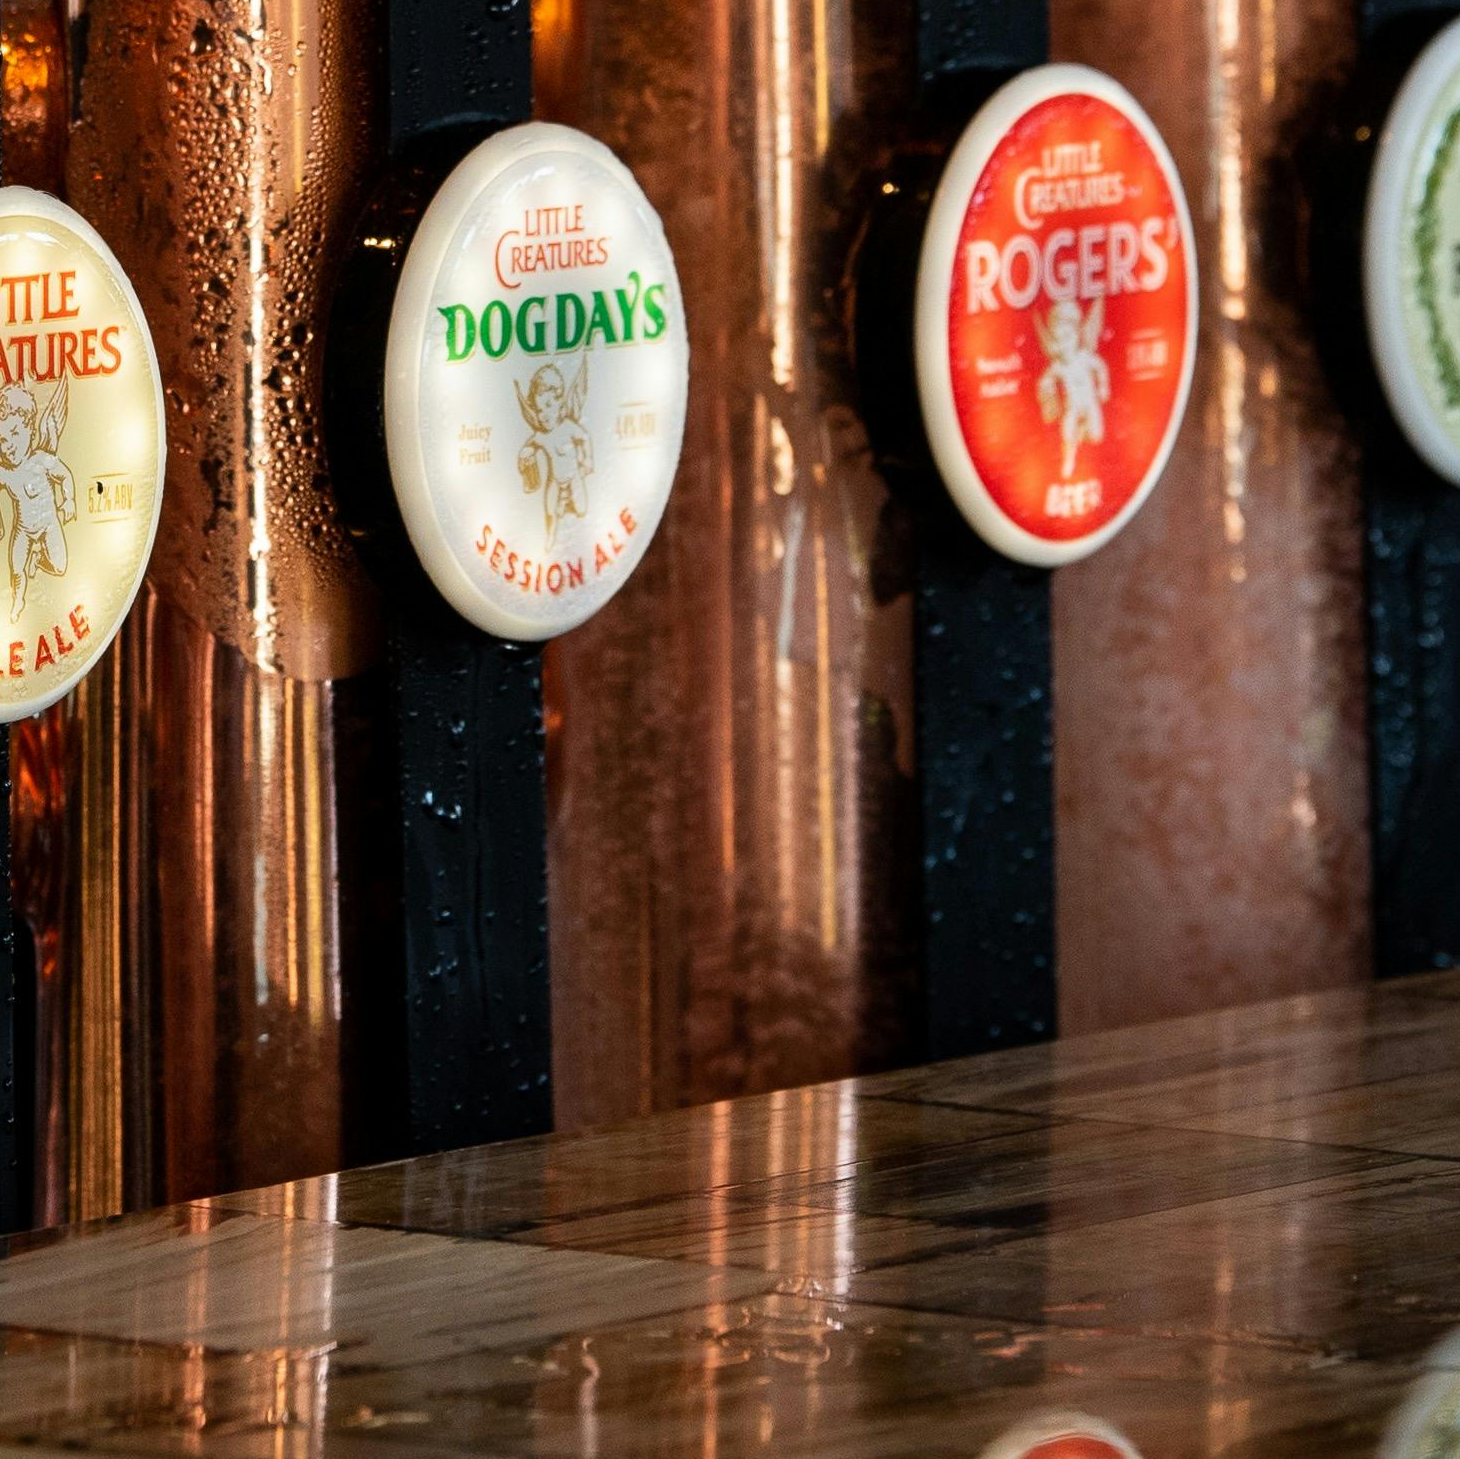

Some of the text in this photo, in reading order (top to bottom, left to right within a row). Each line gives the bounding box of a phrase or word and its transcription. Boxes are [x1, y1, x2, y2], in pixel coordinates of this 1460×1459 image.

[1042, 140, 1104, 178] LITTLE
[524, 204, 585, 237] LITTLE
[1013, 167, 1126, 230] CREATURES
[494, 230, 608, 289] CREATURES
[476, 508, 638, 594] SESSION ALE
[35, 604, 92, 672] ALE
